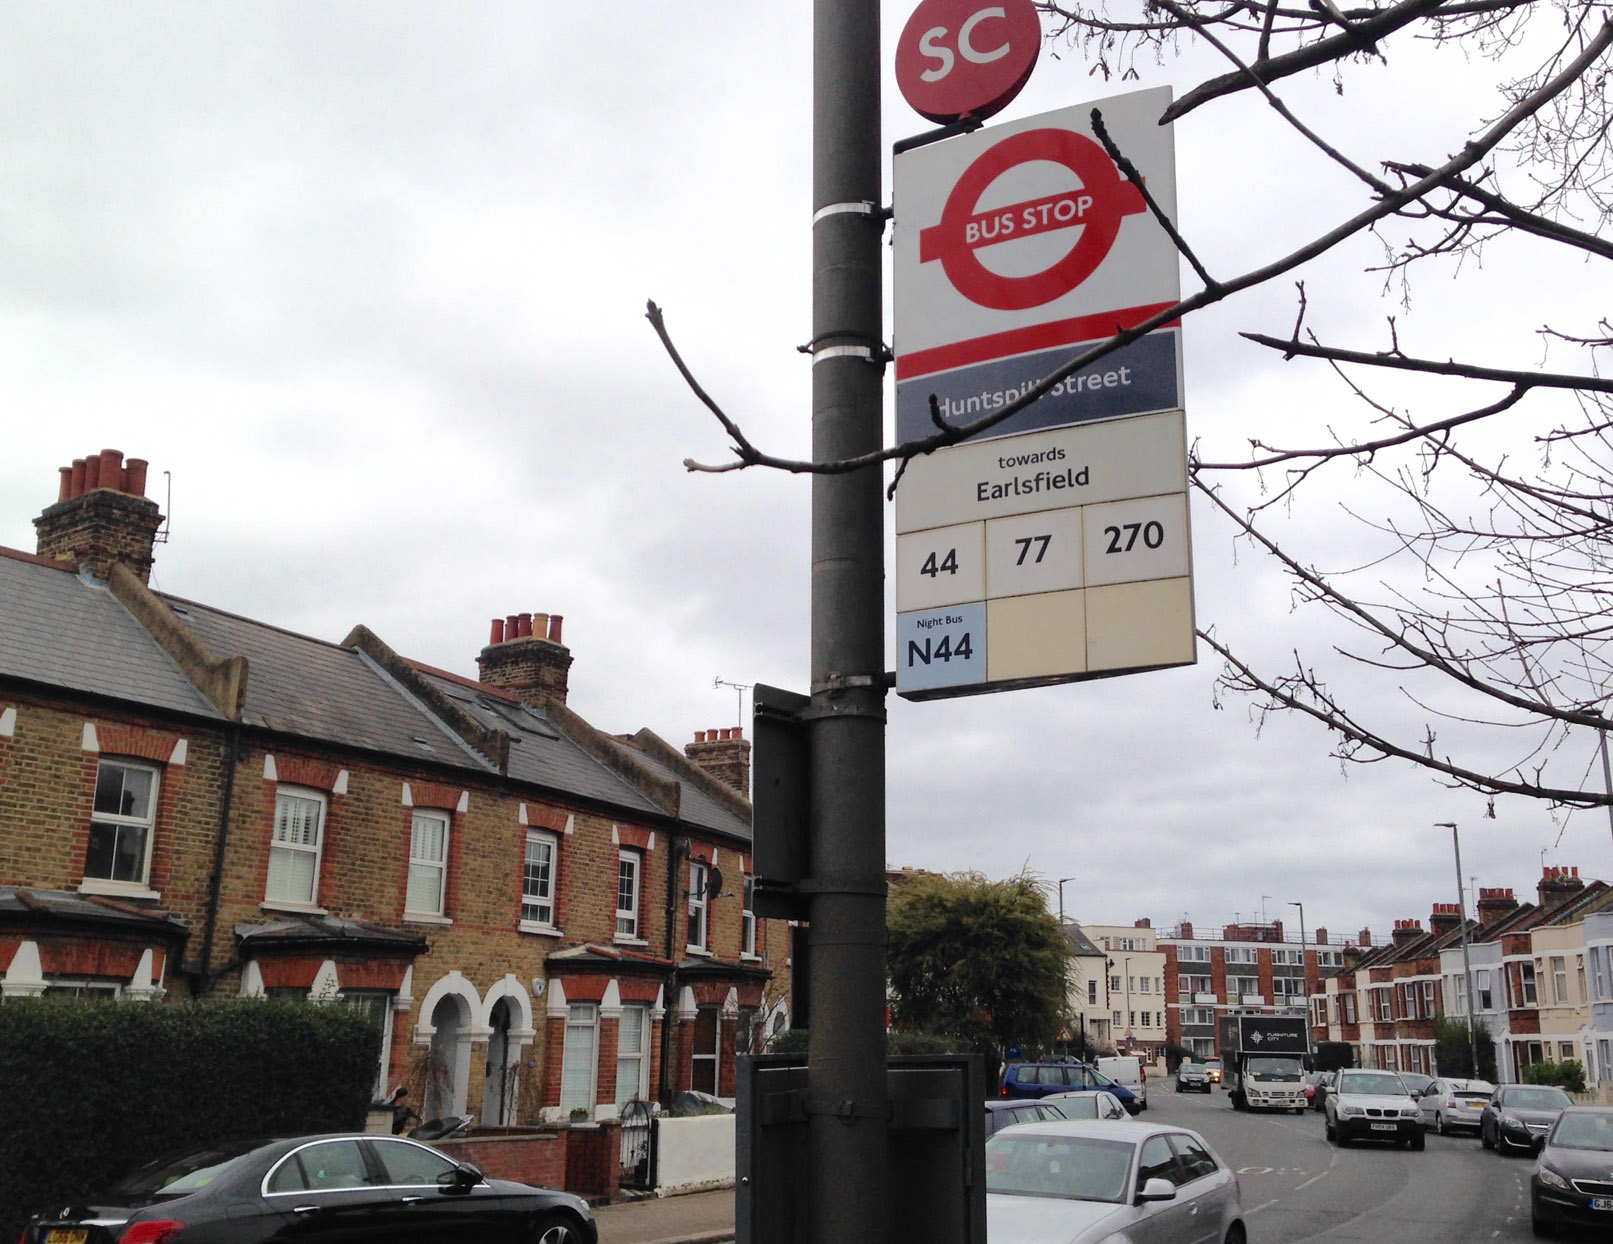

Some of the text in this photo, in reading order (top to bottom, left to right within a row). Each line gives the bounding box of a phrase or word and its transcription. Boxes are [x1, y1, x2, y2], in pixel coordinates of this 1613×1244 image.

[918, 6, 1011, 83] SC
[965, 195, 1093, 244] BUS STOP
[1050, 366, 1132, 397] Street
[998, 447, 1066, 469] towards
[976, 466, 1090, 502] Earlsfield
[1015, 534, 1053, 566] 77
[1104, 520, 1165, 555] 270
[920, 548, 959, 578] 44
[916, 614, 963, 630] Night Bus
[908, 632, 973, 667] N44
